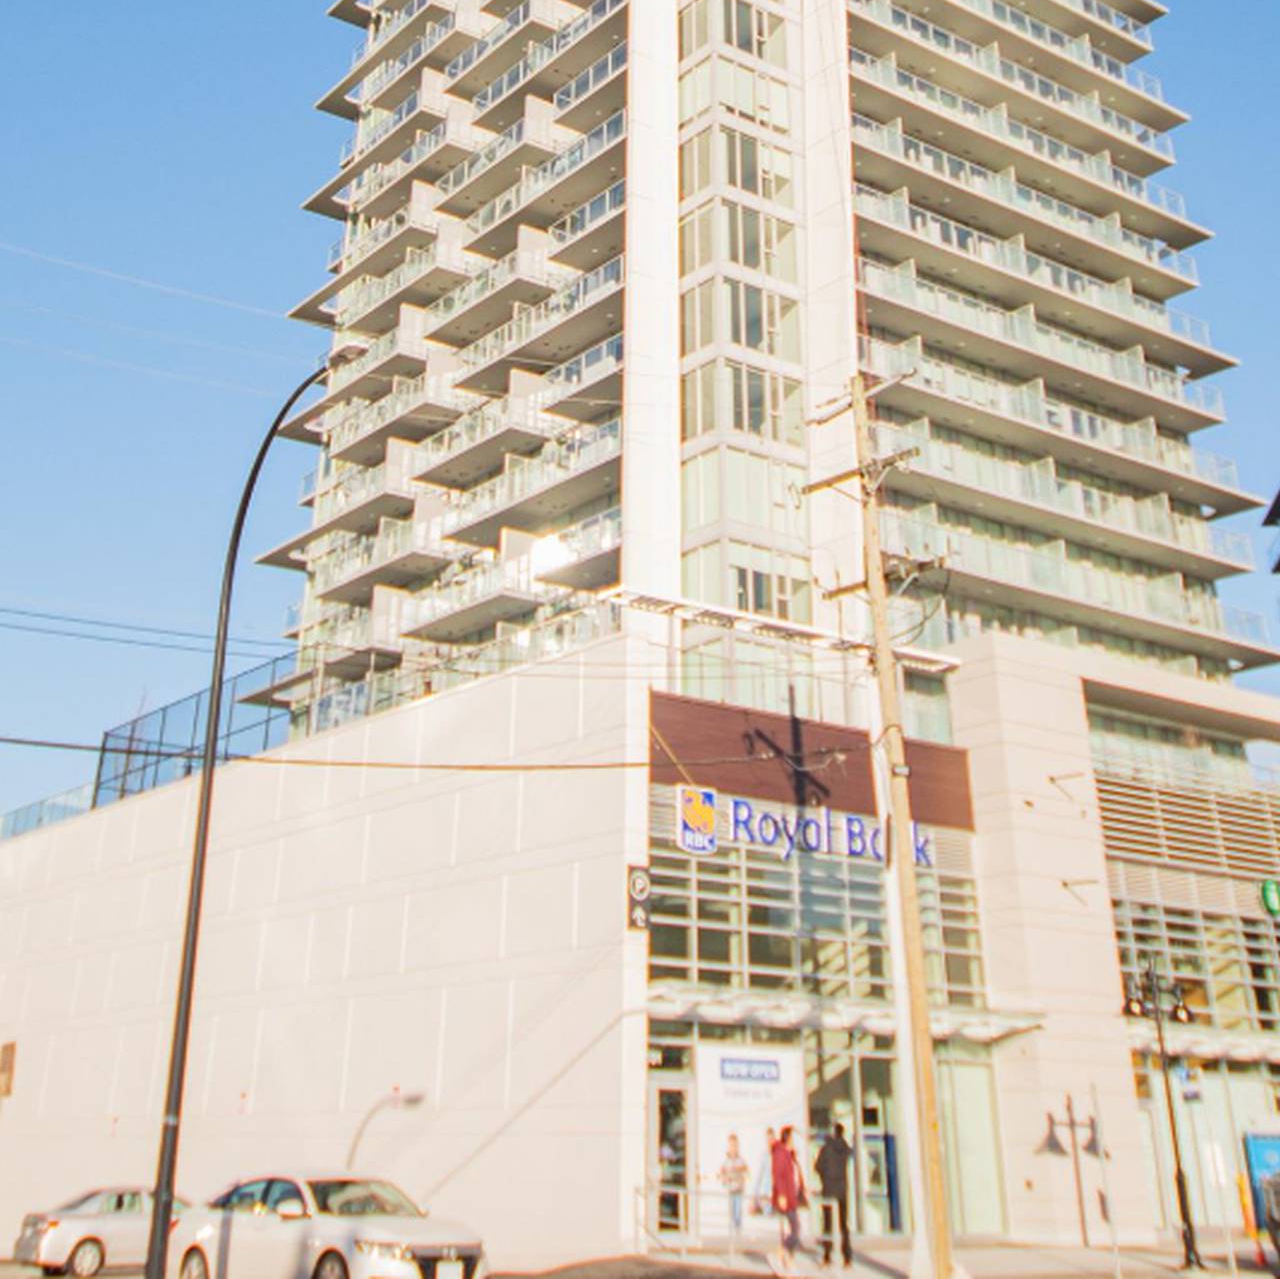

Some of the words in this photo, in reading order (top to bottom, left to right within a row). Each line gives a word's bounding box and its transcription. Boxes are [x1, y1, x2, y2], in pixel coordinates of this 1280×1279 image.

[685, 830, 715, 851] RBC
[730, 799, 832, 861] Royal
[845, 815, 933, 866] Bak
